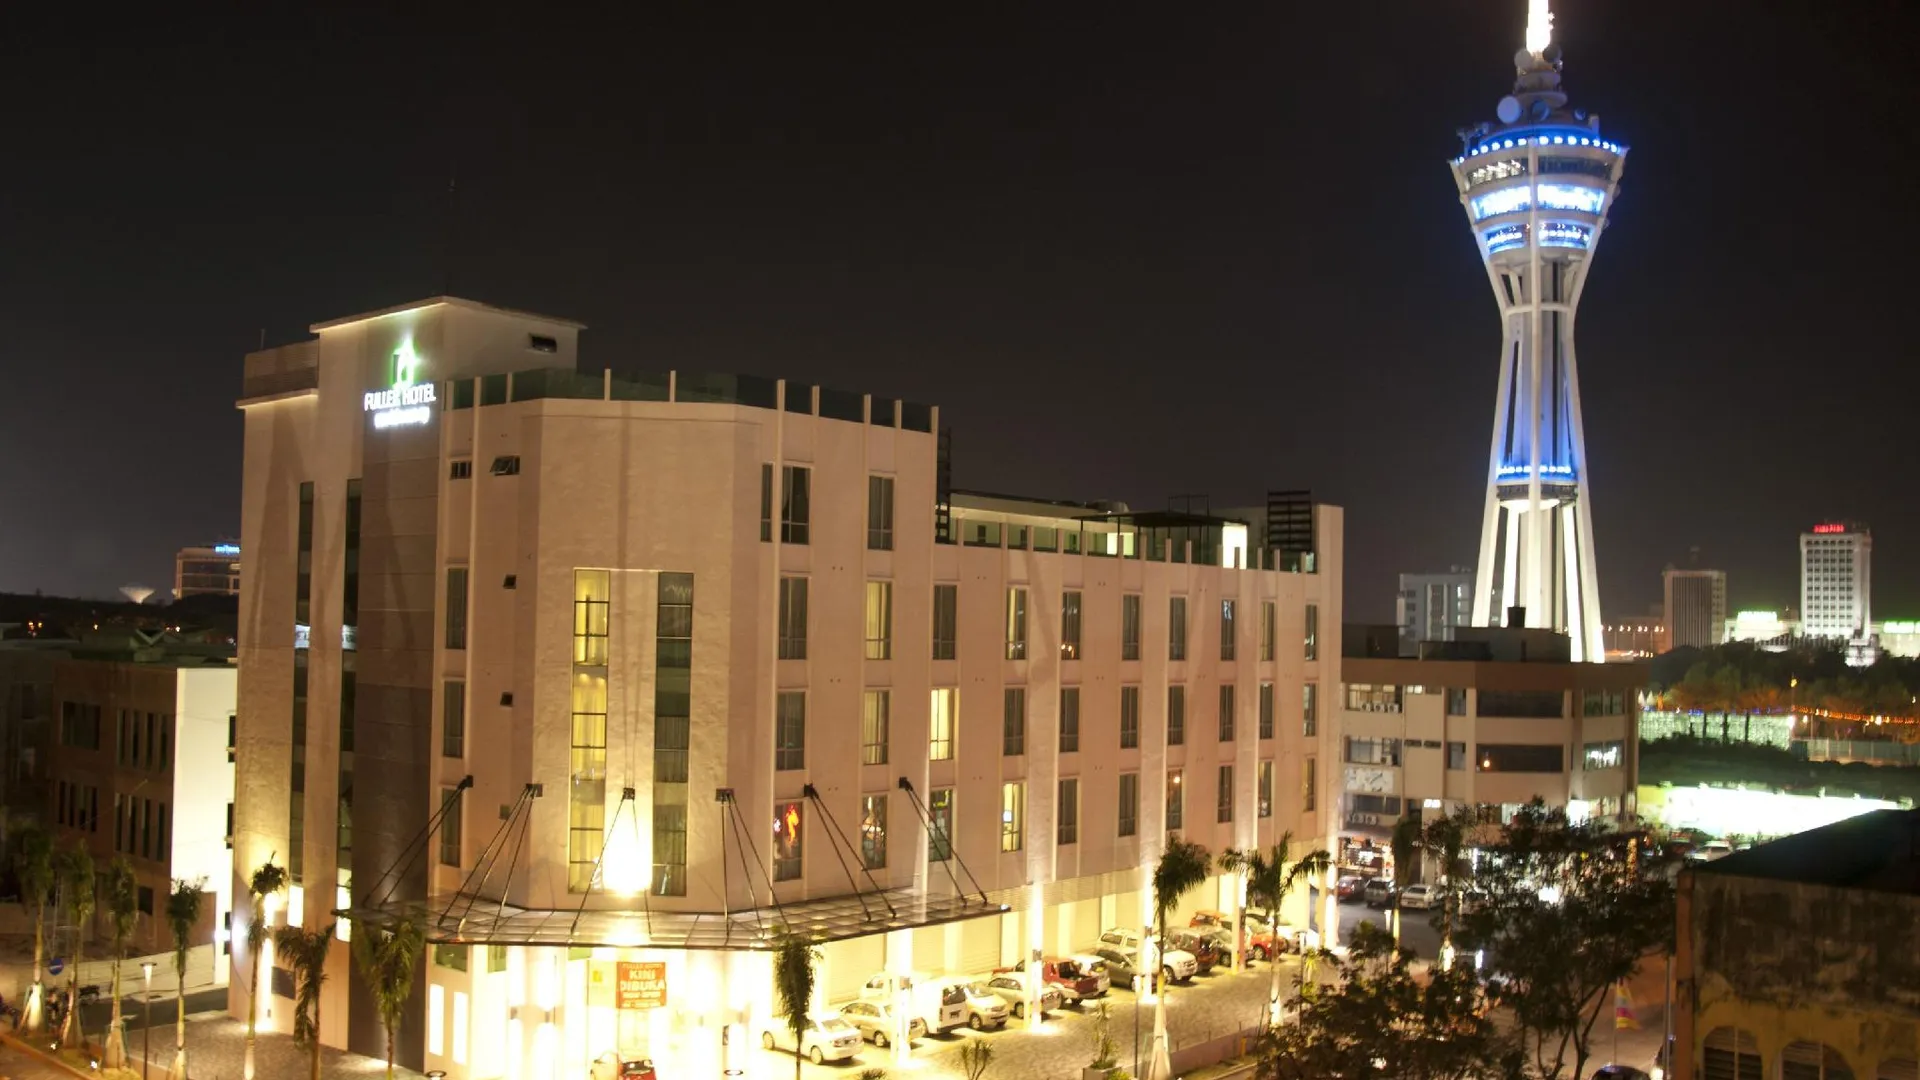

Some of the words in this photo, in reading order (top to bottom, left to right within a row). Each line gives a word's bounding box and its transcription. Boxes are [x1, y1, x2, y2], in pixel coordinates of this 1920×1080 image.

[402, 383, 436, 405] HOTEL
[629, 969, 655, 980] KINI
[620, 980, 666, 991] DIBUKA
